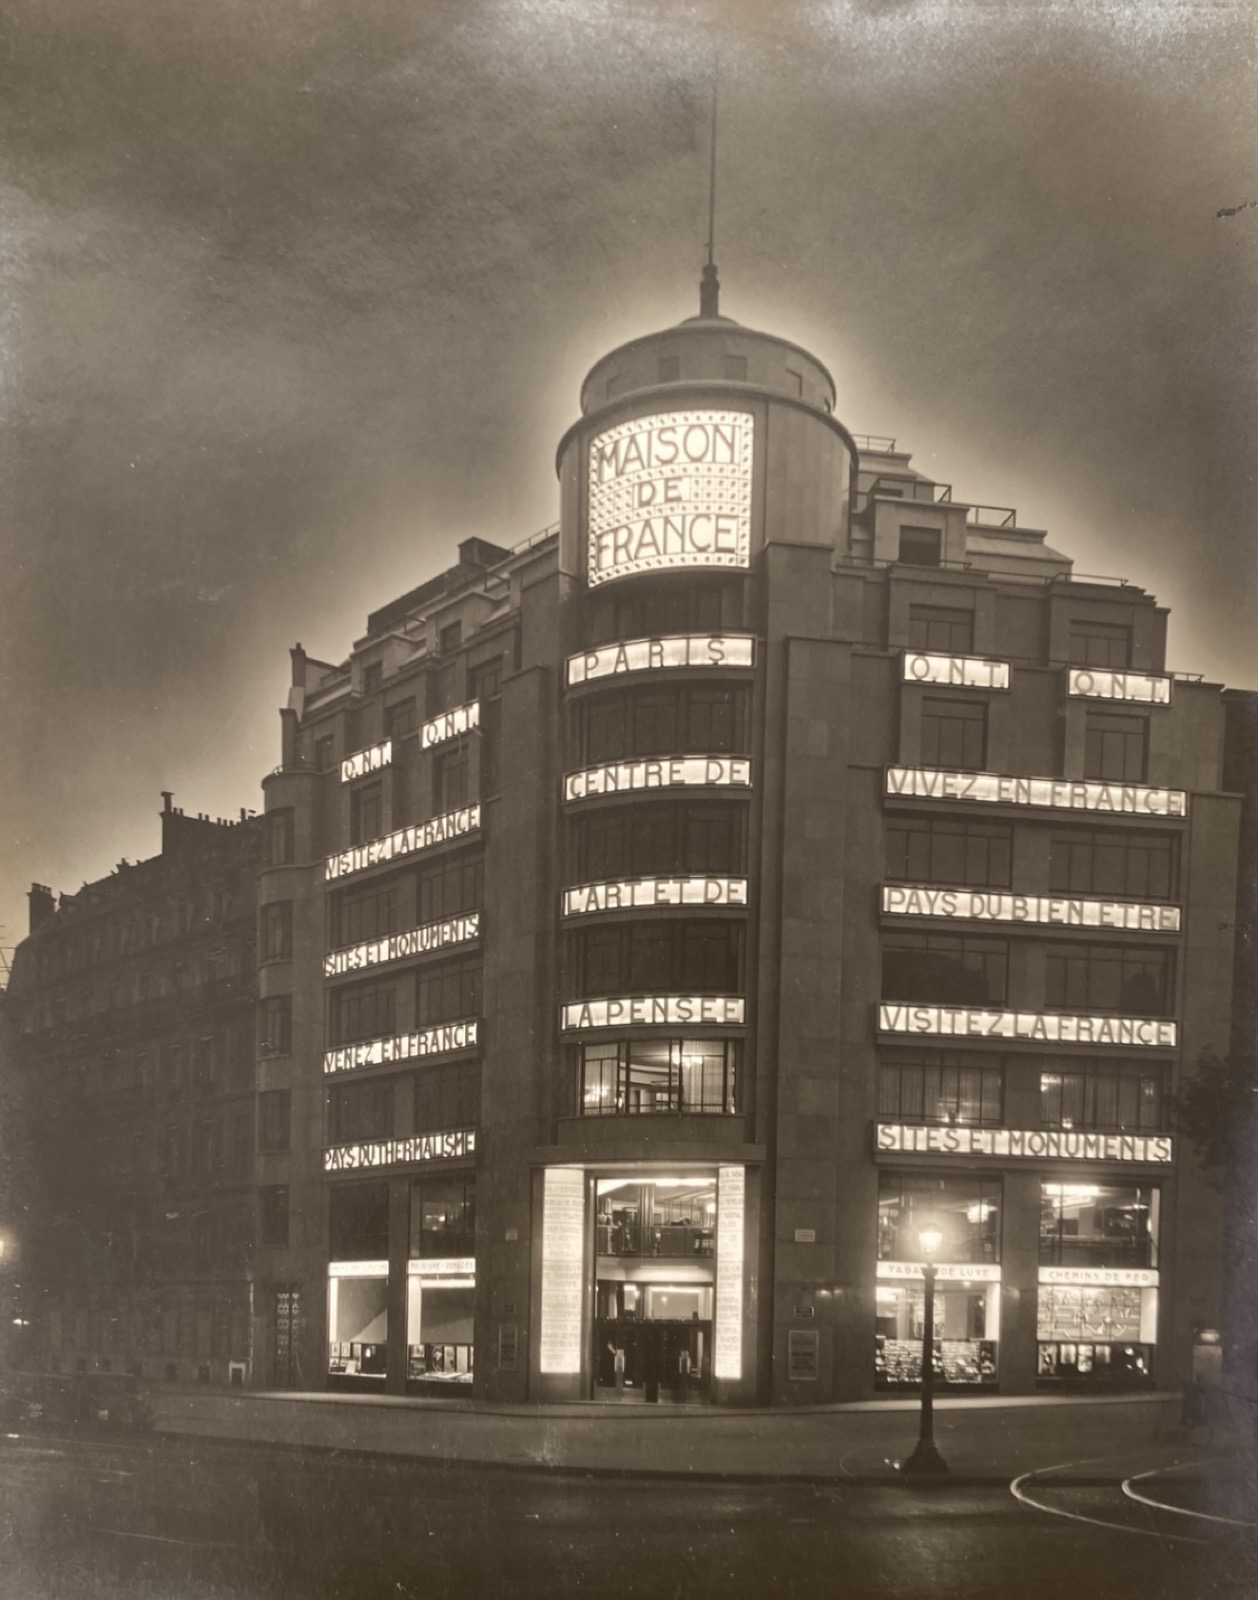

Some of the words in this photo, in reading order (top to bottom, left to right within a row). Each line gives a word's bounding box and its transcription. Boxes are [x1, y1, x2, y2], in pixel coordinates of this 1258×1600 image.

[600, 424, 736, 486] MAISON
[637, 477, 684, 508] DE
[596, 514, 738, 574] FRANCE
[585, 638, 725, 680] PARIS
[569, 761, 685, 798] CENTRE
[706, 760, 746, 784] DE
[889, 769, 978, 799] VIVEZ
[998, 778, 1031, 803] EN
[1053, 783, 1183, 814] FRANCE
[326, 840, 388, 877] VISITEZ
[392, 829, 410, 854] LA
[414, 806, 479, 848] FRANCE
[568, 882, 642, 912] L'ART
[655, 880, 690, 904] ET
[705, 879, 743, 904] DE
[887, 889, 957, 915] PAYS
[970, 894, 1001, 918] DU
[1012, 896, 1083, 924] BIEN
[1100, 902, 1177, 930] ETRE
[325, 947, 363, 974] SITES
[367, 943, 384, 964] ET
[388, 915, 478, 958] MONUMENTS
[566, 1003, 593, 1028] LA
[607, 998, 740, 1024] PENSEE
[883, 1006, 1003, 1035] VISITEZ
[1014, 1014, 1048, 1038] LA
[1059, 1018, 1174, 1045] FRANCE
[325, 1044, 374, 1073] VENEZ
[382, 1038, 401, 1061] EN
[408, 1023, 476, 1056] FRANCE
[325, 1146, 355, 1170] PAYS
[359, 1144, 374, 1166] DU
[376, 1132, 474, 1164] THERMALISME
[878, 1125, 960, 1151] SITES
[969, 1130, 996, 1153] ET
[1009, 1131, 1169, 1161] MONUMENTS
[941, 1267, 955, 1277] DE
[960, 1268, 989, 1277] LUXE
[1105, 1272, 1119, 1281] DE
